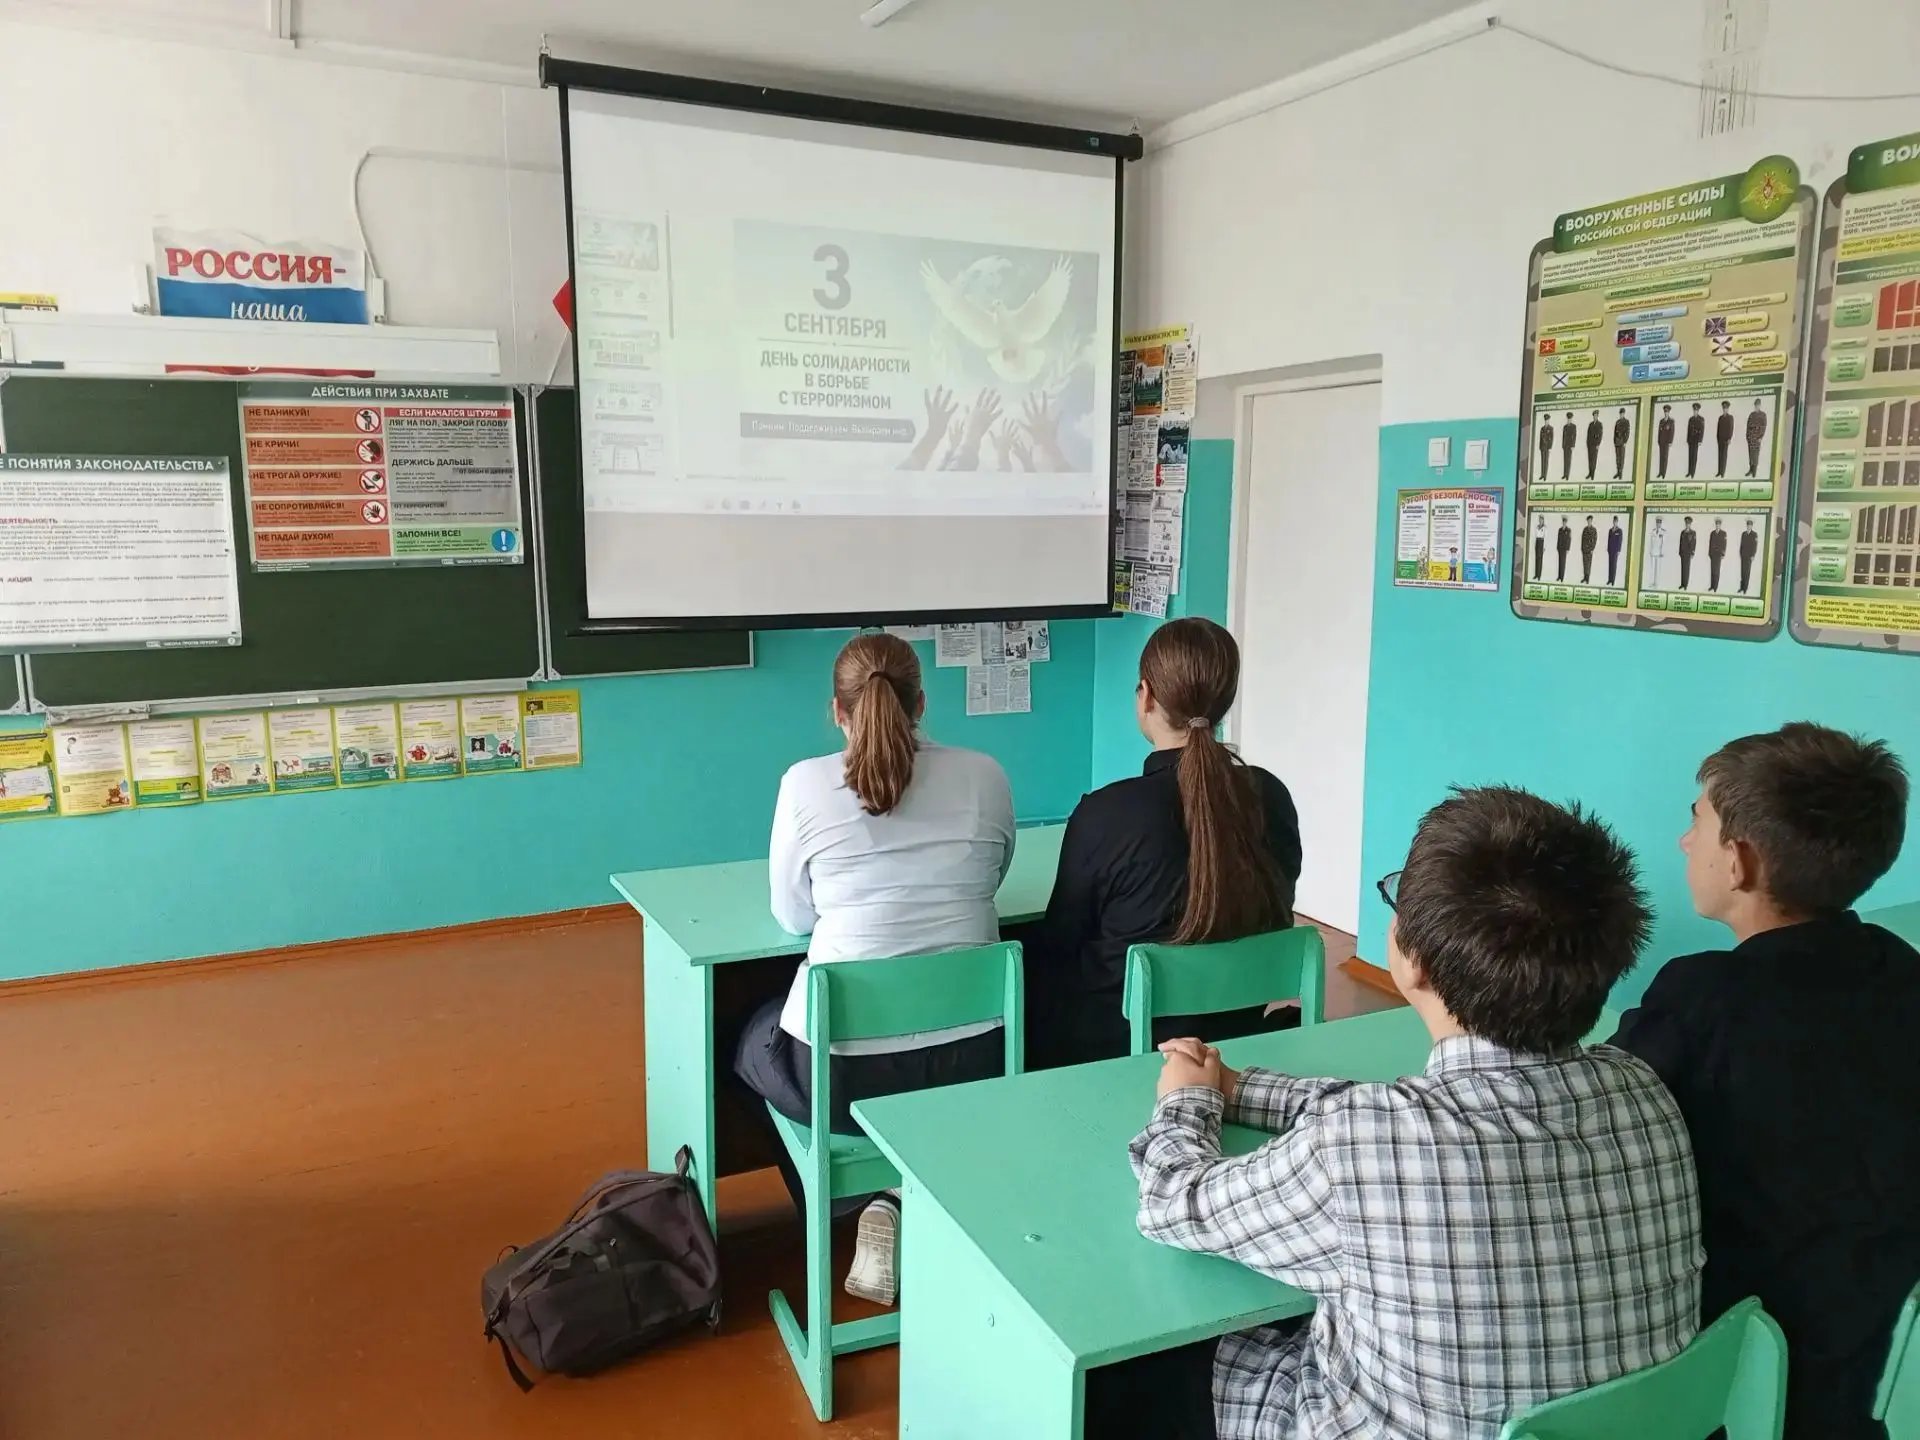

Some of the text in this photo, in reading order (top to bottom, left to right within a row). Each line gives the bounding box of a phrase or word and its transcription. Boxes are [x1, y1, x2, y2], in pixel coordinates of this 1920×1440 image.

[1566, 184, 1726, 232] ВООРУЖЕННЫЕ СИЛЫ
[1573, 206, 1713, 244] РОССИЙСКОЙ ФЕДЕРАЦИИ
[165, 248, 346, 284] РОССИЯ-
[813, 244, 852, 311] 3
[231, 301, 307, 321] наша
[784, 312, 886, 339] СЕНТЯБРЯ
[760, 350, 911, 373] ДЕНЬ СОЛИДАРНОСТИ
[805, 373, 869, 390] В БОРЬБЕ
[311, 385, 449, 399] ДЕЙСТВИЯ ПРИ ЗАХВАТЕ
[779, 391, 891, 409] С ТЕРРОРИЗМОМ
[249, 407, 310, 417] НЕ ПАНИКУЙ!
[425, 409, 465, 417] НАЧАЛСЯ
[467, 409, 498, 417] ШТУРМ
[420, 419, 441, 428] ПОЛ,
[442, 418, 475, 426] ЗАКРОЙ
[476, 419, 508, 427] ГОЛОВУ
[250, 440, 299, 448] НЕ КРИЧИ!
[8, 458, 71, 470] ПОНЯТИЯ
[75, 459, 214, 471] ЗАКОНОДАТЕЛЬСТВА
[392, 458, 474, 467] ДЕРЖИСЬ ДАЛЬШЕ
[266, 470, 301, 479] ТРОГАЙ
[302, 471, 342, 479] ОРУЖИЕ!
[1434, 491, 1495, 503] БЕЗОПАСНОСТИ
[269, 501, 345, 510] СОПРОТИВЛЯЙСЯ!
[258, 532, 334, 541] НЕ ПАДАЙ ДУХОМ!
[396, 530, 440, 538] ЗАПОМНИ
